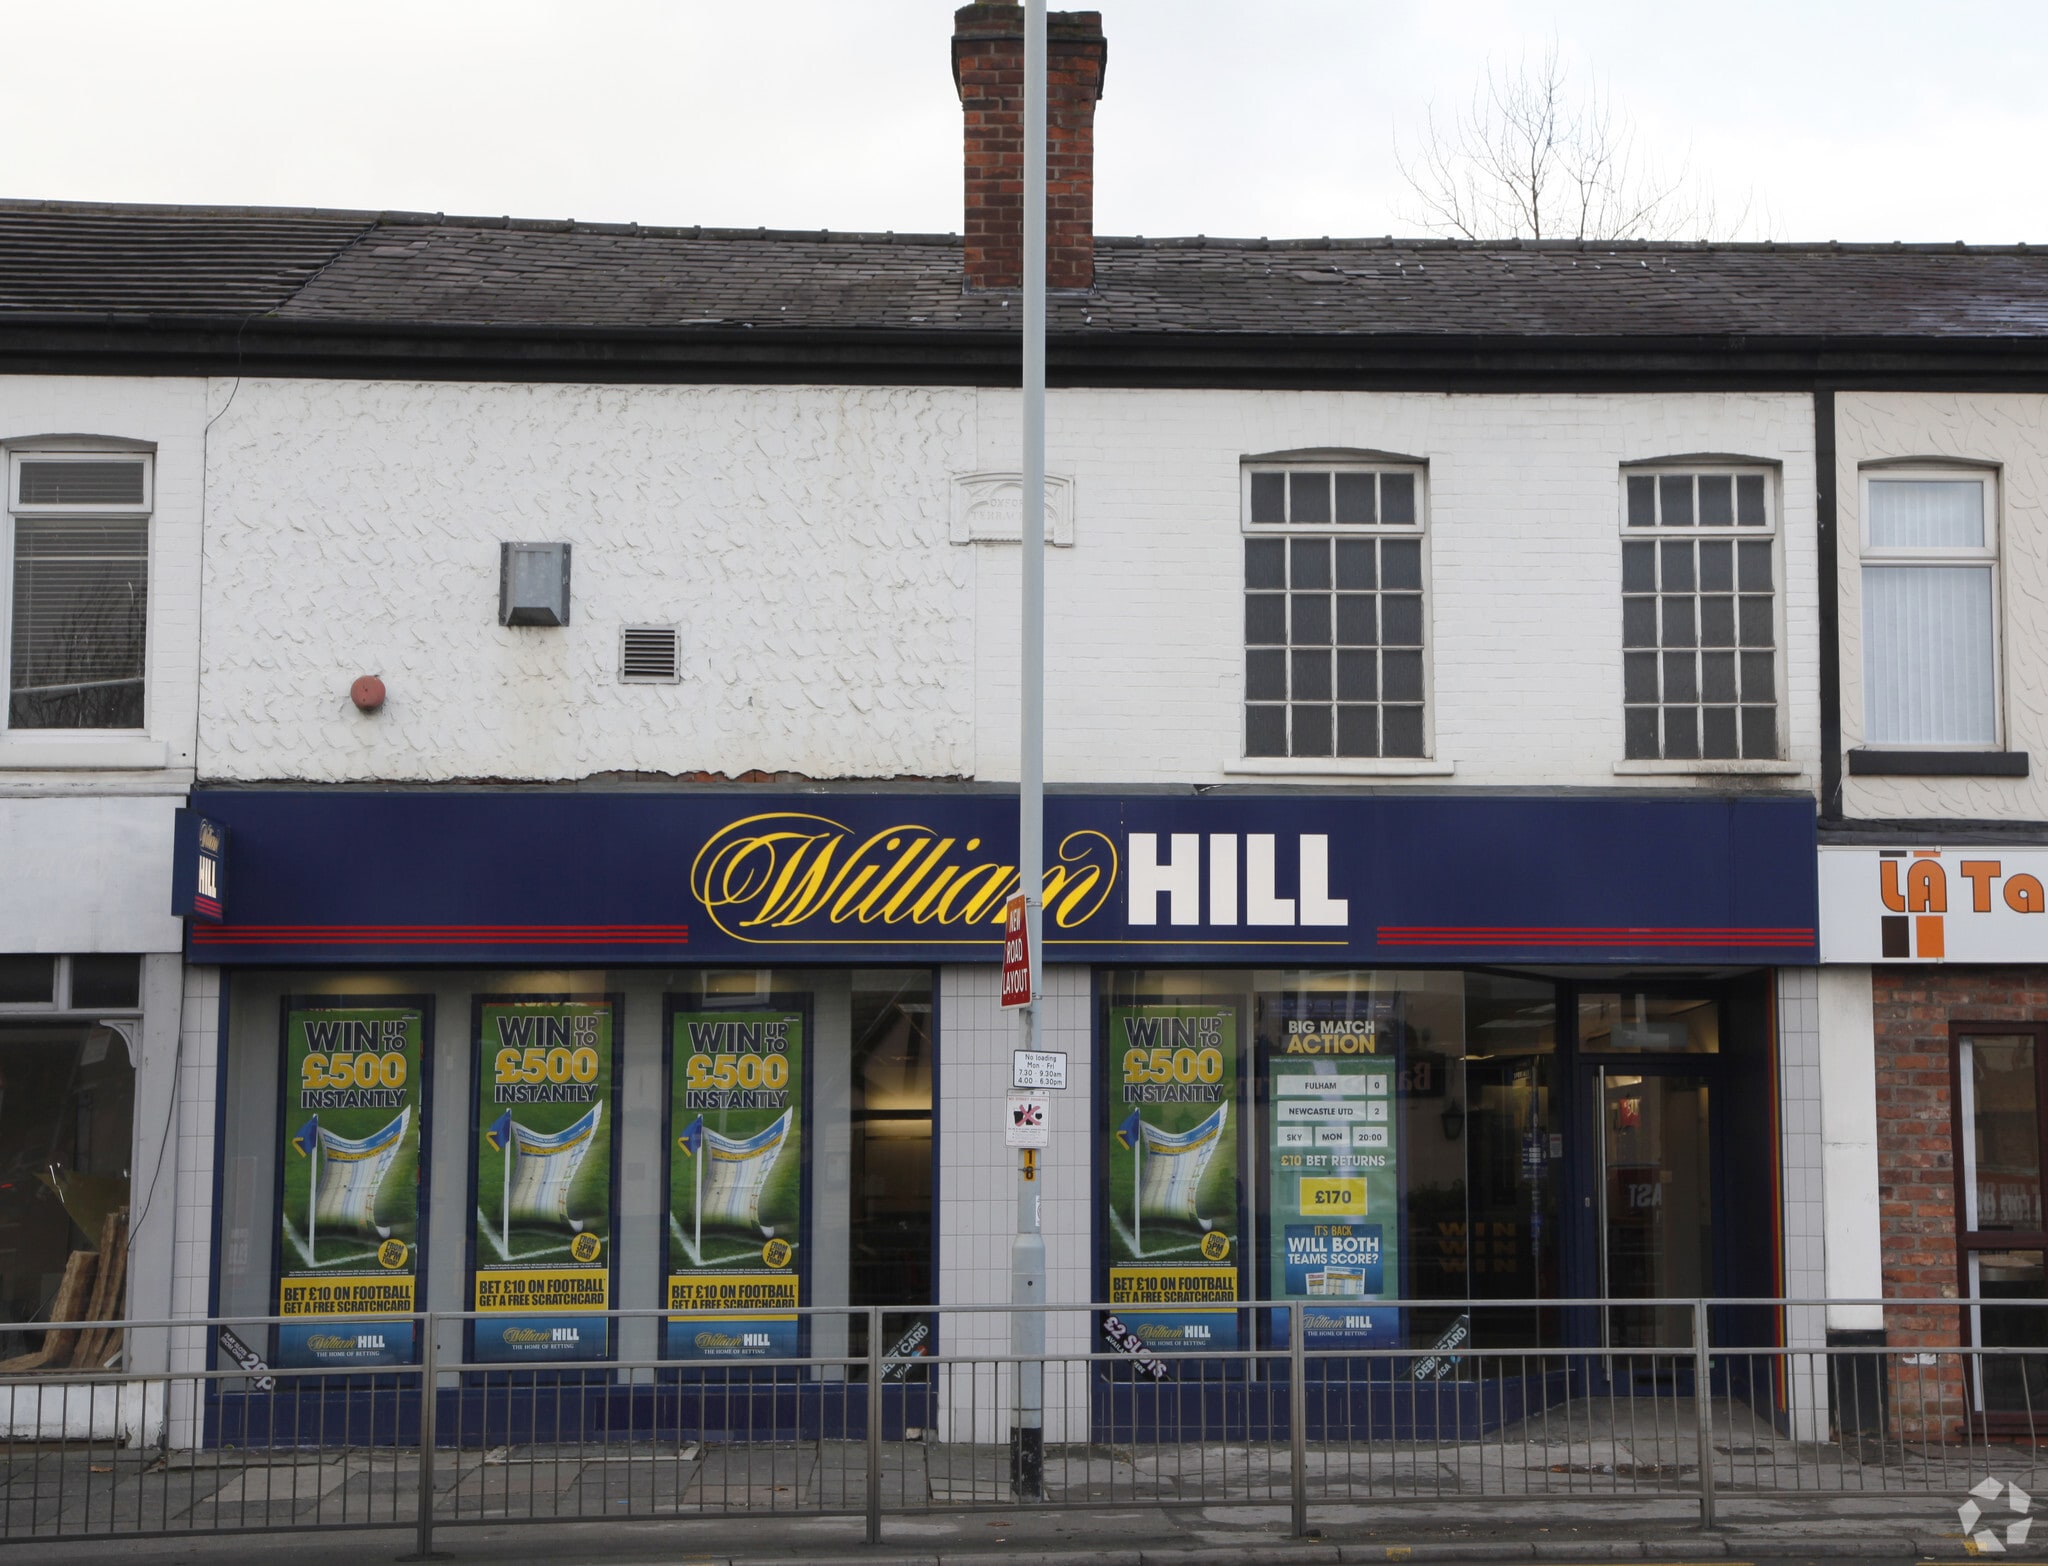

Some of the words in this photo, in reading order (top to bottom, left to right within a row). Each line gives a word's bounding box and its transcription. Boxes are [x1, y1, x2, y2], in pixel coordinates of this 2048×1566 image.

[691, 812, 1117, 942] William
[1128, 833, 1348, 925] HILL
[1880, 860, 1947, 912] LA
[1960, 860, 2045, 914] Ta
[1009, 908, 1021, 932] NEW
[1006, 938, 1022, 964] ROAD
[1002, 968, 1028, 995] LAYOUT
[496, 1016, 571, 1047] WIN
[574, 1016, 598, 1032] UP
[1124, 1017, 1196, 1048] WIN
[1200, 1017, 1222, 1032] UP
[1289, 1020, 1315, 1034] BIG
[1320, 1021, 1375, 1034] MATCH
[304, 1020, 379, 1052] WIN
[384, 1020, 407, 1036] UP
[383, 1036, 406, 1050] TO
[574, 1031, 597, 1046] TO
[688, 1022, 762, 1053] WIN
[766, 1022, 788, 1038] UP
[1199, 1032, 1222, 1047] TO
[765, 1037, 788, 1052] TO
[1286, 1034, 1375, 1054] ACTION
[495, 1048, 599, 1084] £500
[1036, 1054, 1056, 1063] loading
[1123, 1048, 1223, 1084] £500
[301, 1052, 407, 1089] £500
[686, 1054, 788, 1090] £500
[1040, 1078, 1062, 1086] 6.30pm
[301, 1088, 407, 1108] INSTANTLY
[494, 1084, 598, 1103] INSTANTLY
[686, 1090, 788, 1109] INSTANTLY
[1123, 1084, 1223, 1103] INSTANTLY
[1322, 1133, 1342, 1141] MON
[1281, 1155, 1301, 1166] £10
[1306, 1155, 1327, 1166] BET
[1332, 1155, 1385, 1166] RETURNS
[1315, 1190, 1351, 1204] £170
[1314, 1226, 1328, 1236] IT'S
[1332, 1226, 1352, 1236] BACK
[1288, 1238, 1327, 1252] WILL
[1332, 1238, 1379, 1252] BOTH
[1288, 1254, 1327, 1264] TEAMS
[1330, 1253, 1379, 1264] SCORE?
[480, 1281, 502, 1294] BET
[504, 1280, 525, 1294] £10
[528, 1280, 544, 1293] ON
[1113, 1278, 1134, 1290] BET
[1137, 1278, 1157, 1290] £10
[1160, 1277, 1176, 1290] ON
[284, 1288, 306, 1301] BET
[309, 1287, 331, 1300] £10
[334, 1286, 350, 1300] ON
[672, 1286, 693, 1298] BET
[696, 1286, 717, 1298] £10
[720, 1285, 736, 1298] ON
[1114, 1292, 1132, 1303] GET
[1132, 1292, 1139, 1302] A
[1142, 1292, 1162, 1302] FREE
[1164, 1292, 1234, 1302] SCRATCHCARD
[284, 1302, 304, 1314] GET
[304, 1302, 312, 1313] A
[314, 1301, 335, 1313] FREE
[338, 1300, 410, 1312] SCRATCHCARD
[480, 1295, 499, 1306] GET
[500, 1294, 507, 1306] A
[508, 1294, 529, 1306] FREE
[532, 1293, 604, 1305] SCRATCHCARD
[672, 1300, 690, 1310] GET
[692, 1300, 697, 1309] A
[700, 1300, 721, 1309] FREE
[724, 1300, 794, 1309] SCRATCHCARD
[1104, 1316, 1126, 1339] £2
[1346, 1316, 1372, 1328] HILL
[553, 1328, 579, 1341] HILL
[1185, 1325, 1211, 1338] HILL
[358, 1335, 385, 1348] HILL
[744, 1334, 770, 1346] HILL
[900, 1326, 928, 1353] CARD
[1440, 1326, 1467, 1353] CARD
